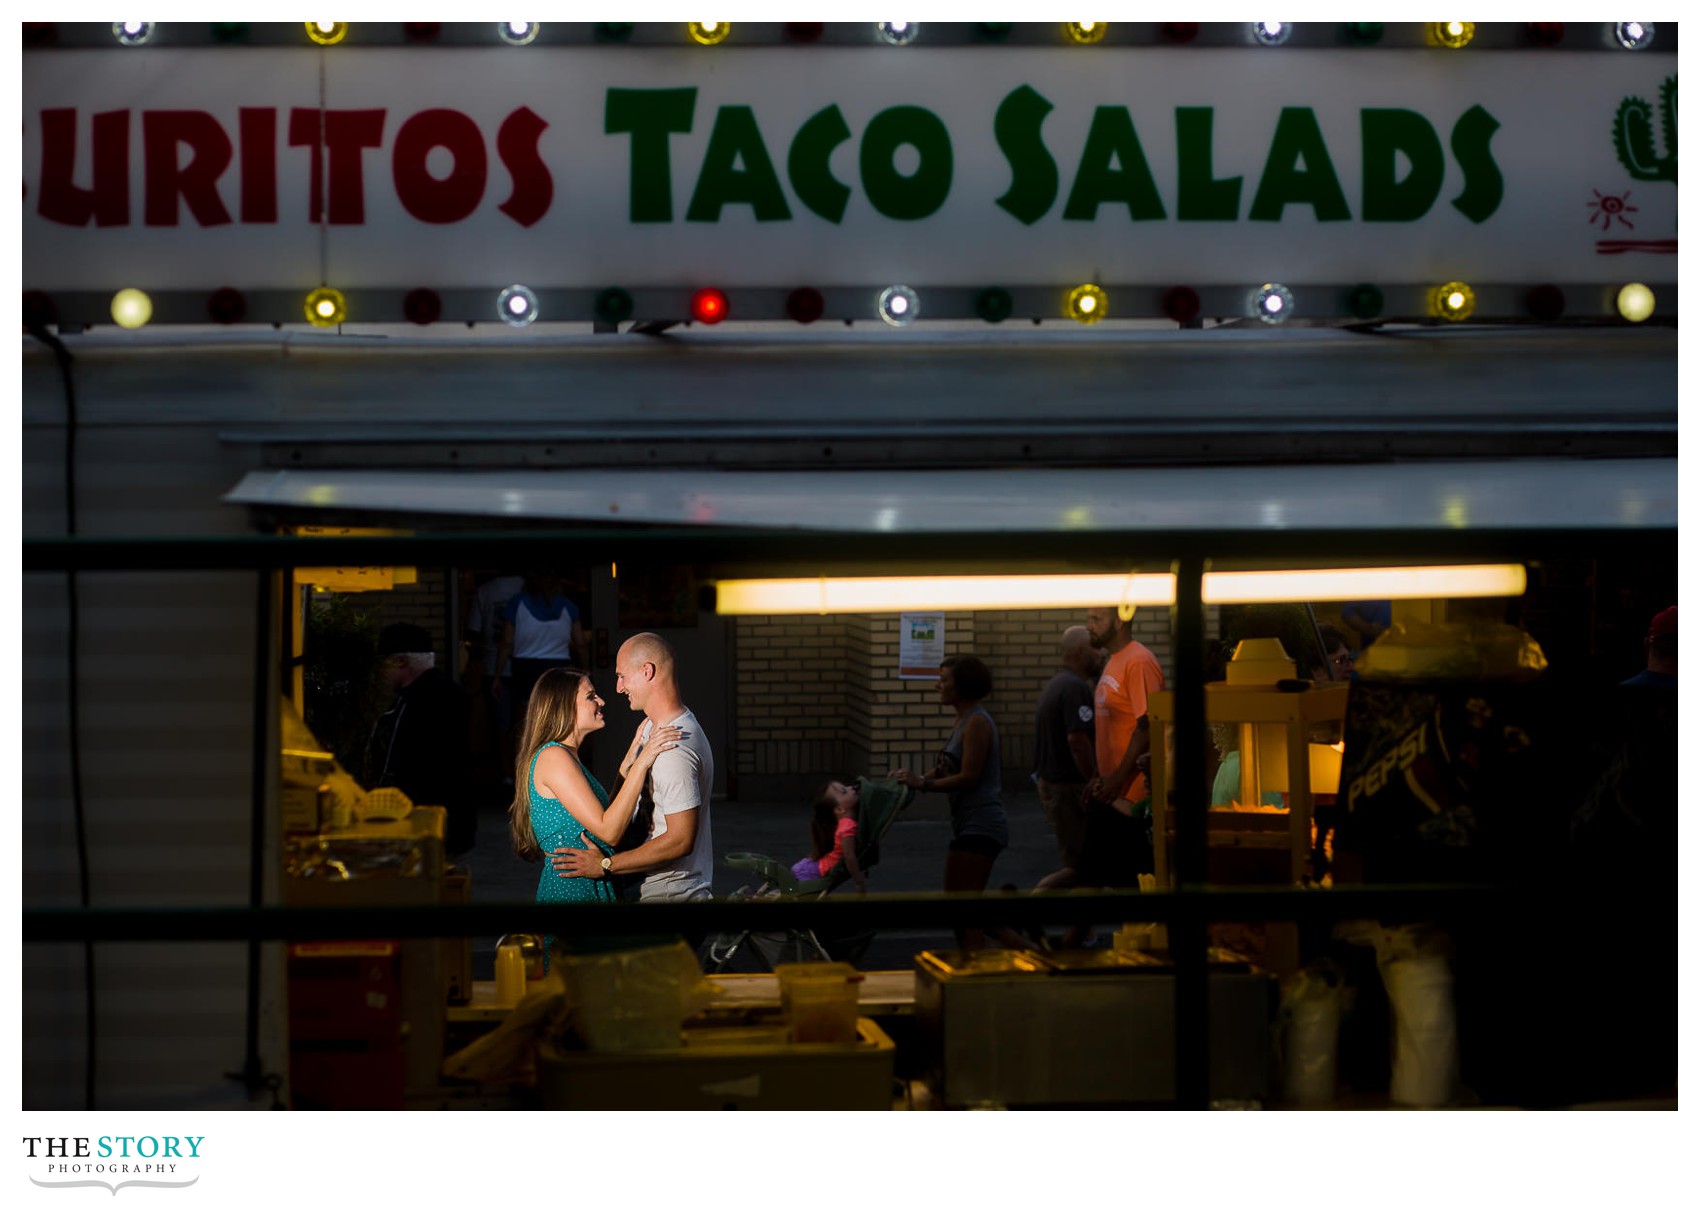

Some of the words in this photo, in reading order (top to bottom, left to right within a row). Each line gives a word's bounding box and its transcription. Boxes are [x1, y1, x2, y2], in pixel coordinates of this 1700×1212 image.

[22, 107, 555, 228] URITOS
[604, 86, 955, 225] TACO
[993, 84, 1504, 226] SALADS
[1347, 720, 1429, 815] PEPSI
